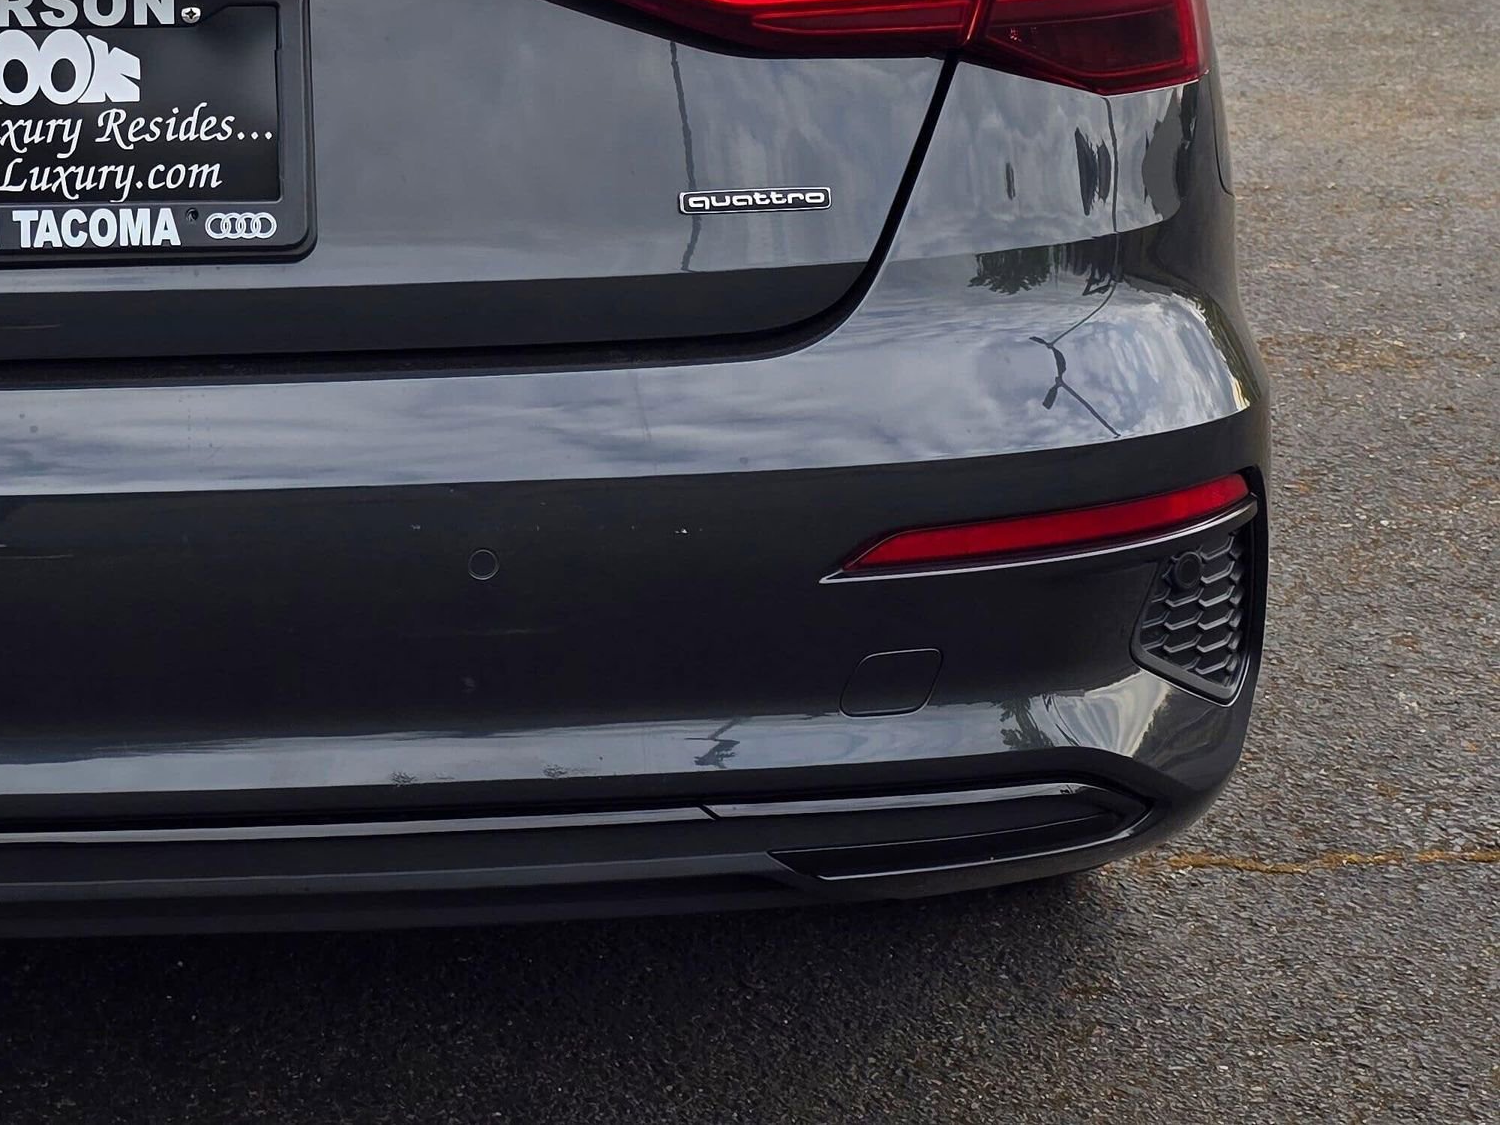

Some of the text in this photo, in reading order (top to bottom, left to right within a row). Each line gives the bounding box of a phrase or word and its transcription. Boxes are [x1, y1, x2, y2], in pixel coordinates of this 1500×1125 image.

[95, 102, 273, 150] Resides...
[688, 191, 825, 210] quattro
[12, 208, 181, 248] TACOMA
